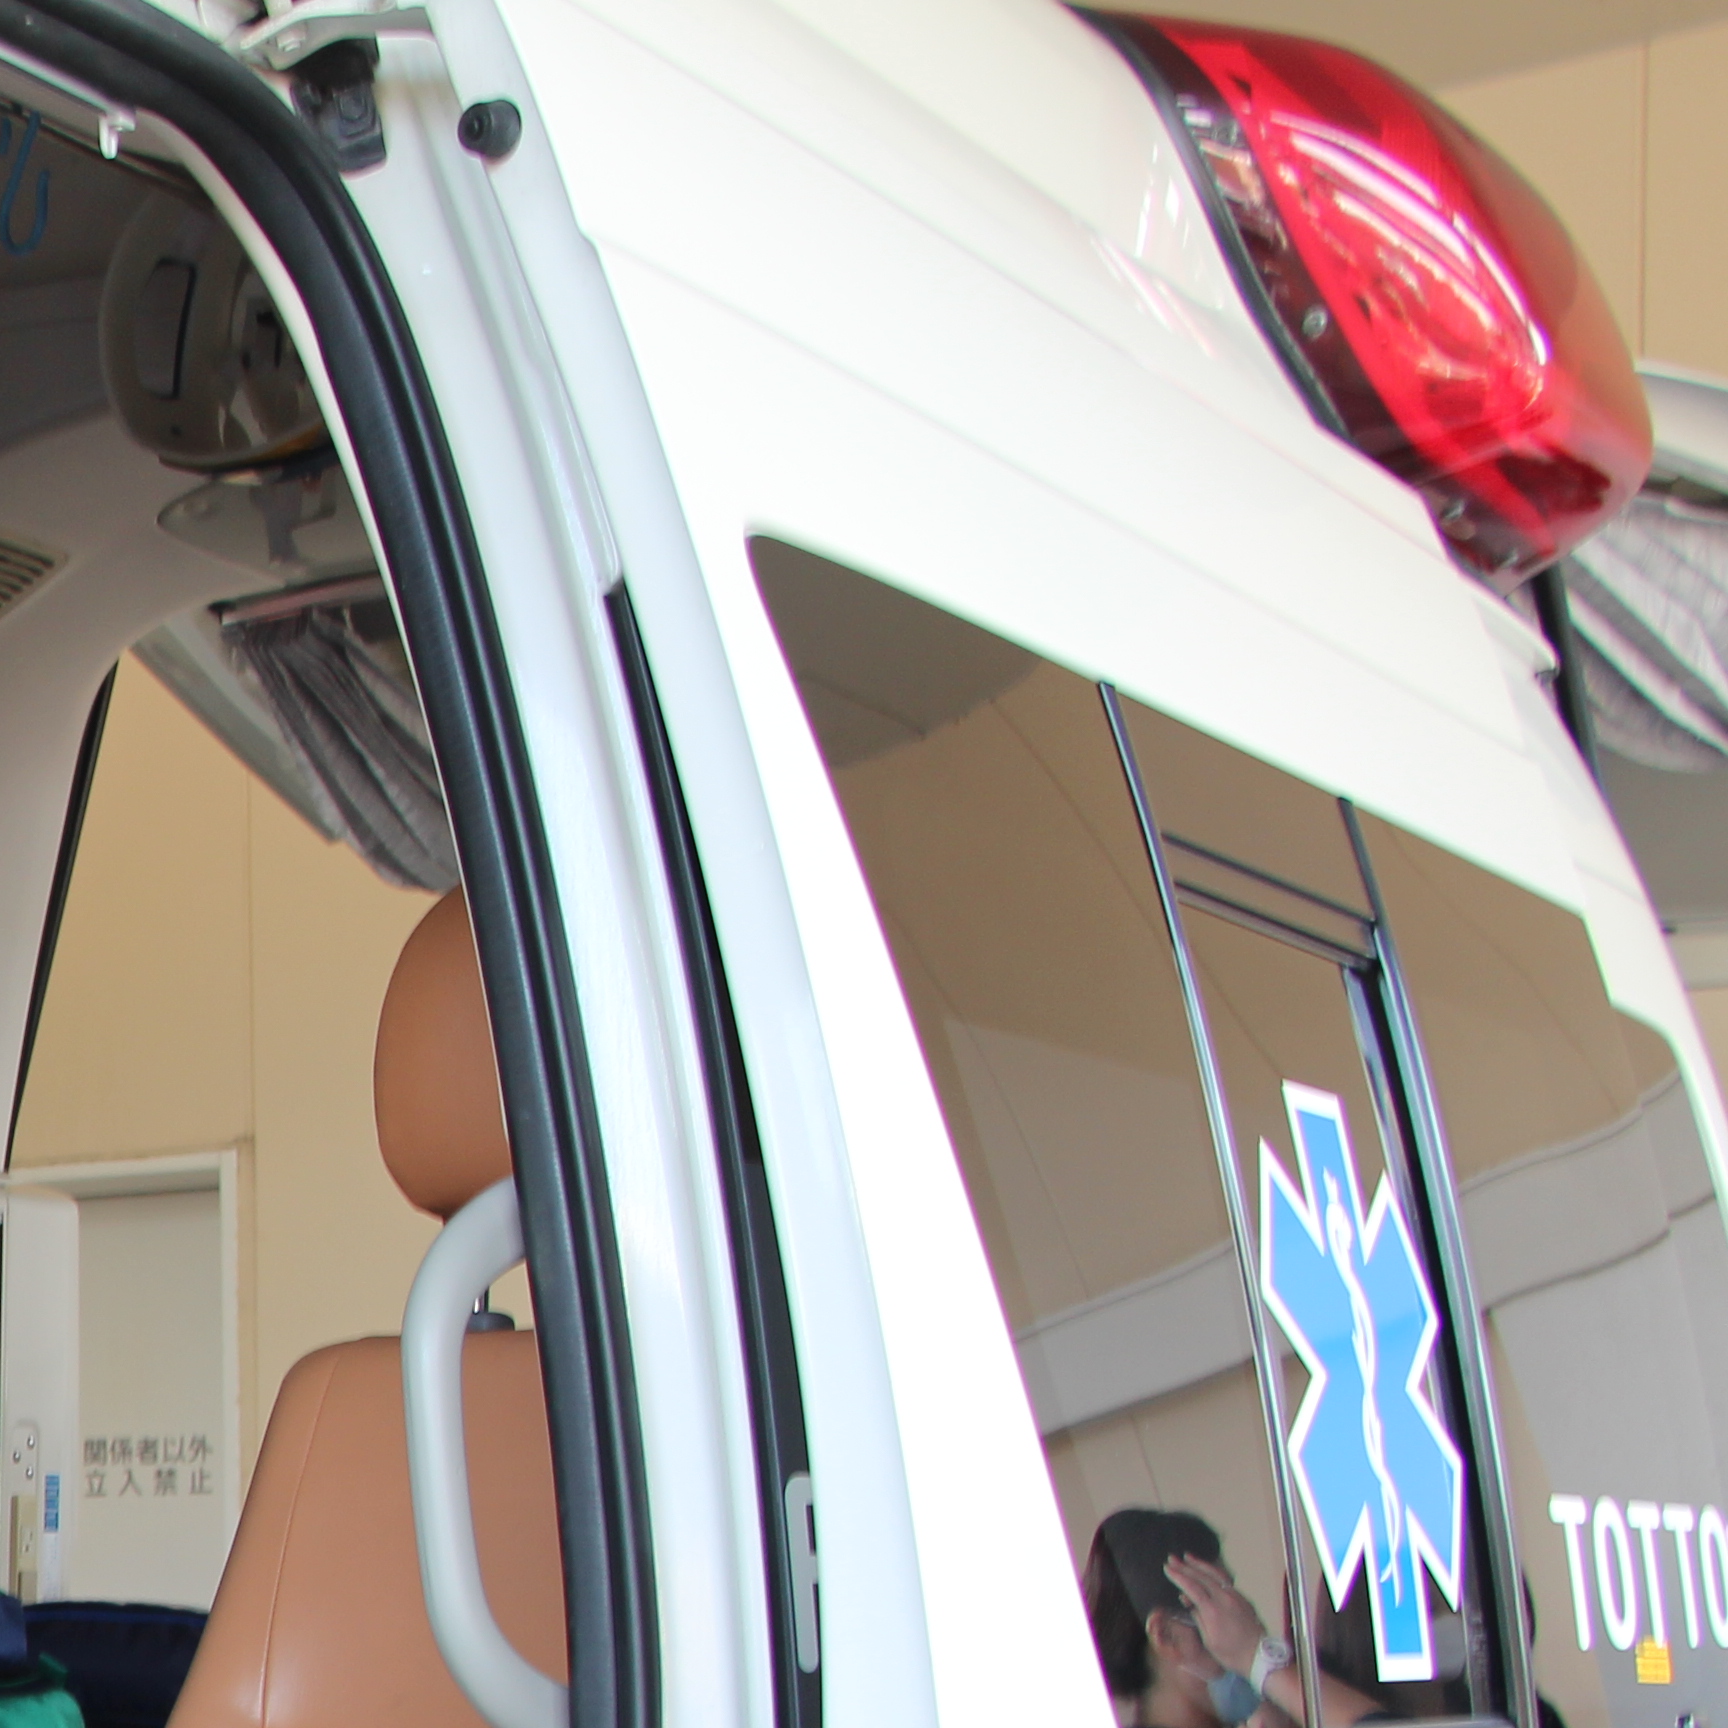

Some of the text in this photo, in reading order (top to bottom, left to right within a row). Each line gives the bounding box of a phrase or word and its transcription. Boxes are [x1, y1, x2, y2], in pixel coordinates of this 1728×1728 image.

[83, 1434, 213, 1466] 関係者以外
[84, 1467, 213, 1498] 立入禁止
